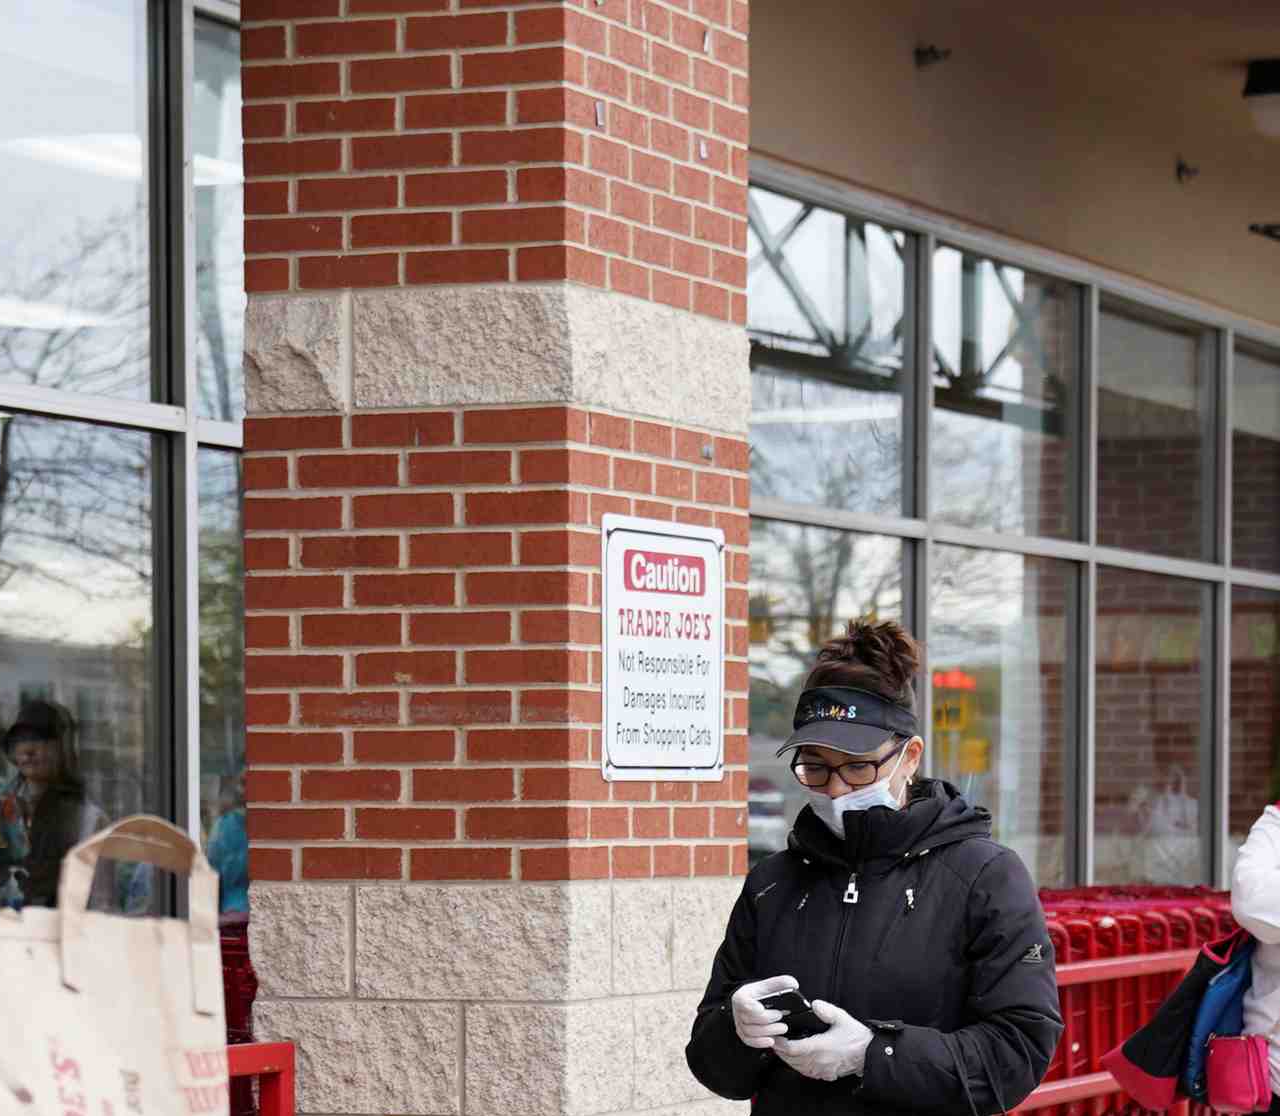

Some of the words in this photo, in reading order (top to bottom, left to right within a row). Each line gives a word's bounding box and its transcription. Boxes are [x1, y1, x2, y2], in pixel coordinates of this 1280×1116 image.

[630, 552, 701, 594] Caution
[618, 607, 671, 640] TRADER
[675, 612, 712, 641] JOE'S
[618, 651, 635, 672] Not
[637, 650, 694, 676] Responsible
[696, 653, 710, 674] For
[623, 686, 667, 715] Damages
[669, 690, 706, 711] Incurred
[616, 722, 640, 745] From
[643, 725, 686, 751] Shopping
[688, 725, 712, 748] Carts
